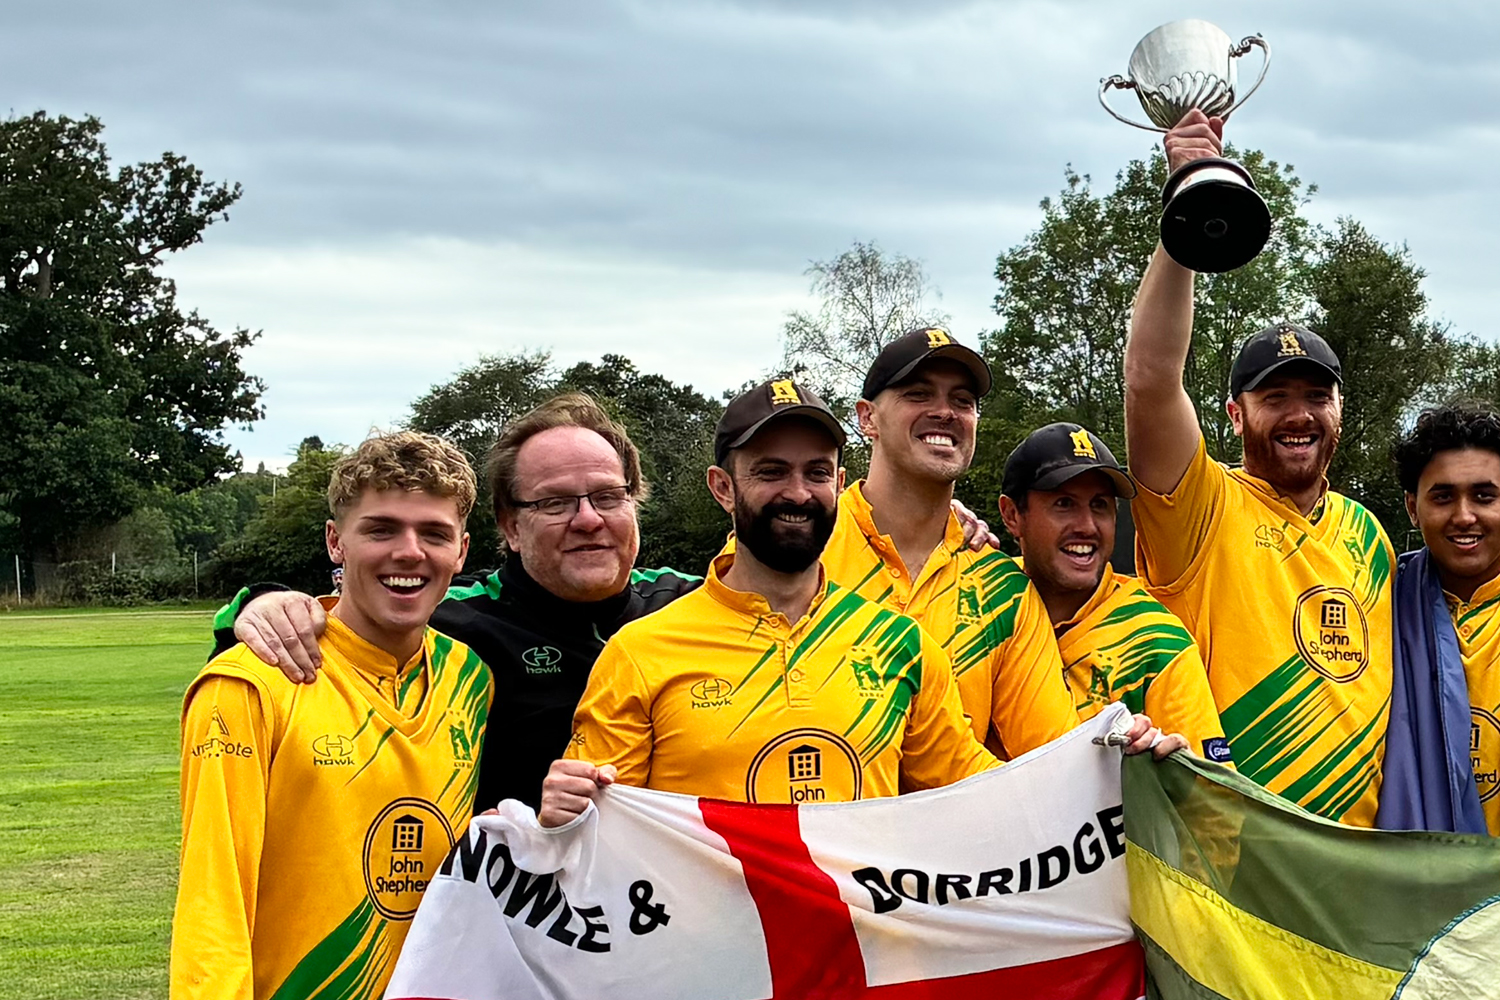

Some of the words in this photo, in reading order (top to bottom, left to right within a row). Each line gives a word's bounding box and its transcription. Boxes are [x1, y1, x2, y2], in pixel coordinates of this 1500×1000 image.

[1320, 630, 1350, 646] John
[526, 664, 561, 674] hawk
[691, 697, 733, 709] hawk
[314, 757, 355, 766] hawk
[789, 784, 825, 804] John
[389, 855, 424, 877] John
[375, 874, 430, 897] Shepher
[439, 826, 611, 953] NOWLE
[628, 879, 671, 935] &
[851, 803, 1126, 914] DORRIDGE
